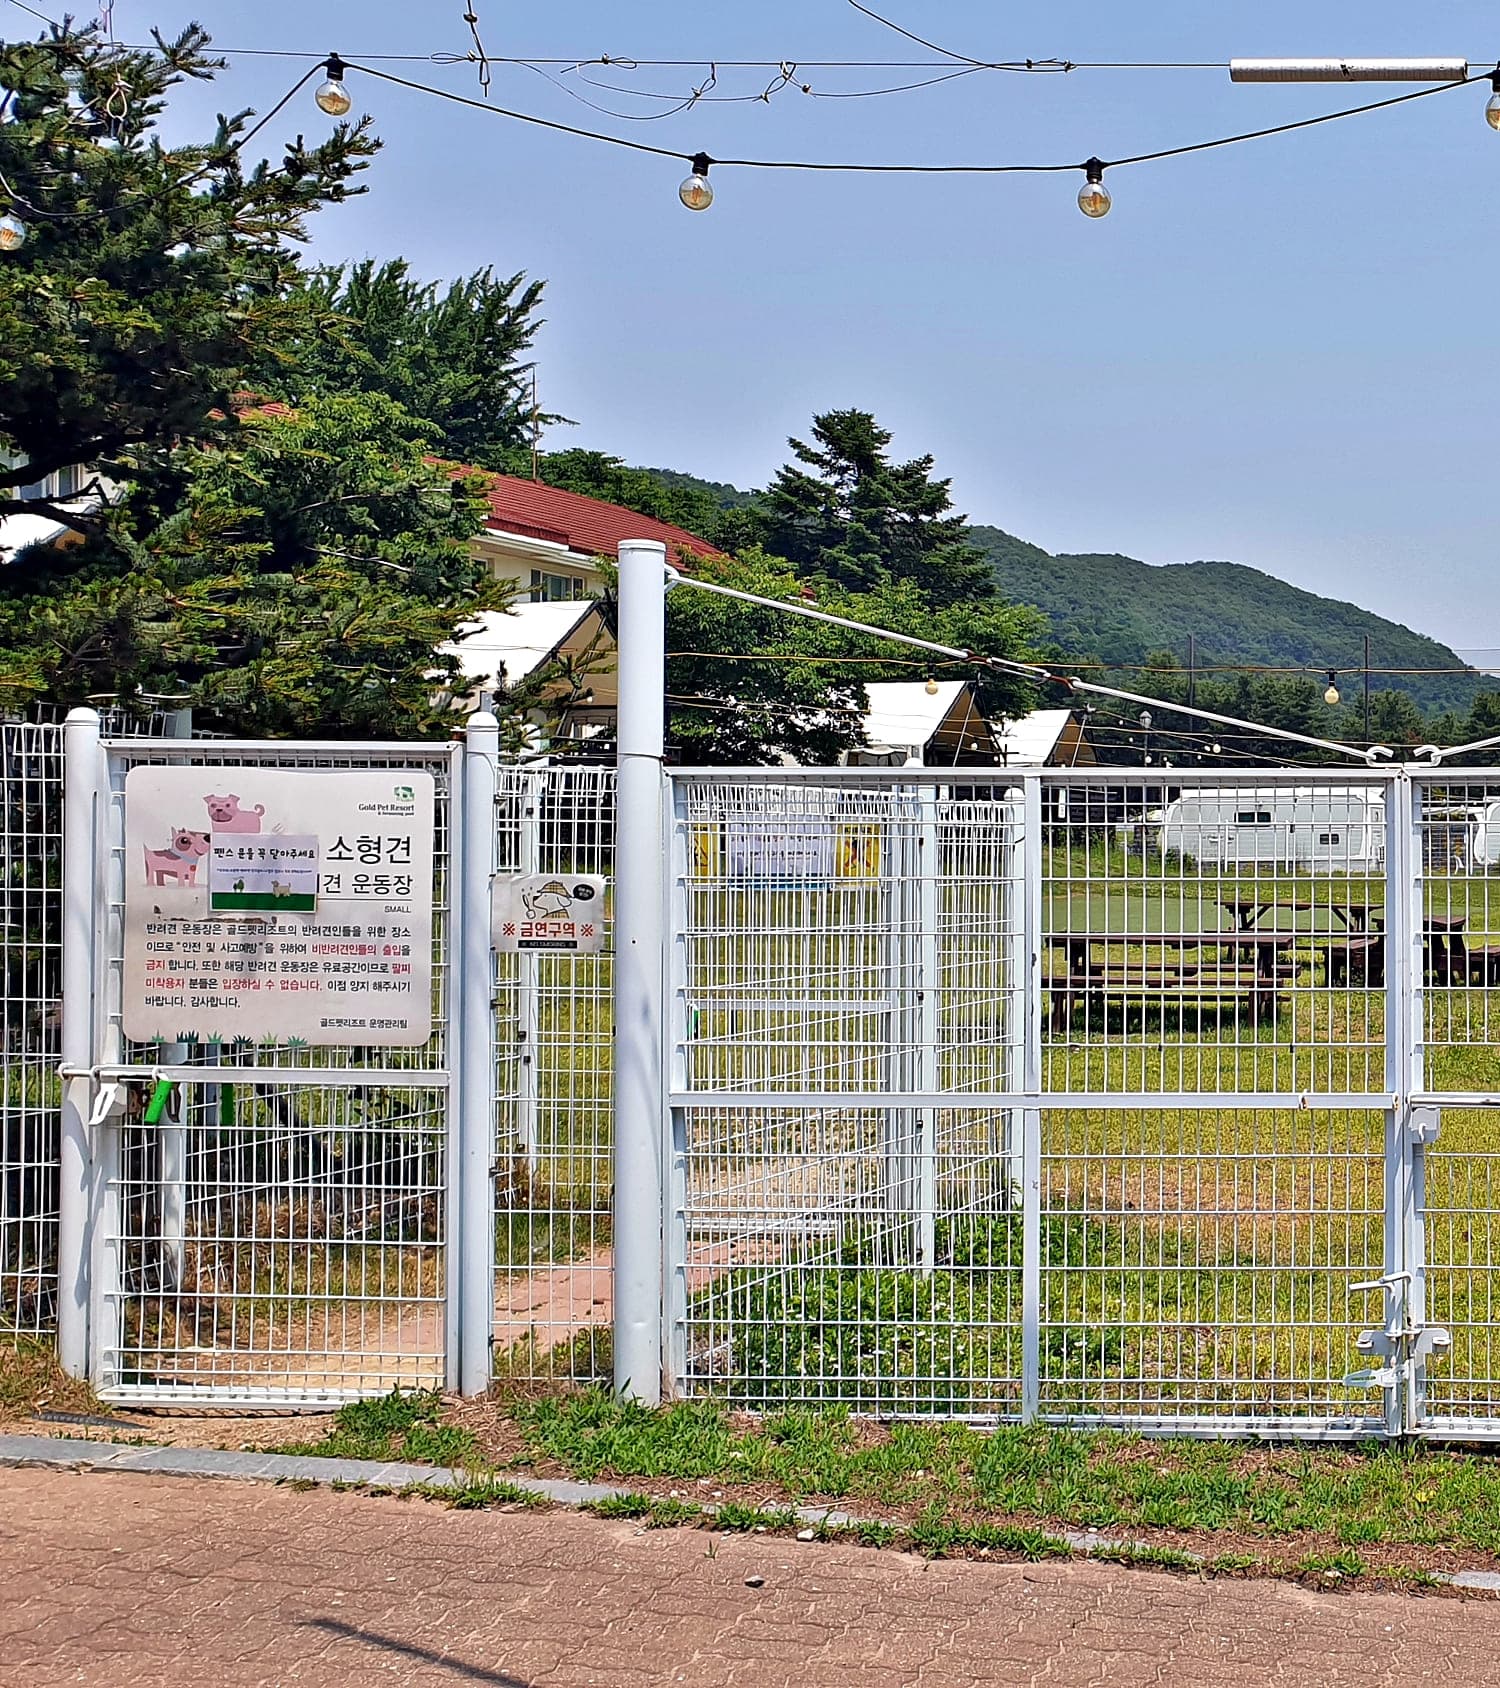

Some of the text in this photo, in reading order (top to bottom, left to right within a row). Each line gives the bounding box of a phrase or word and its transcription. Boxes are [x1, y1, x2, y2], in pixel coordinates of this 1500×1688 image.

[326, 835, 411, 865] 소형견
[351, 874, 413, 895] 운동장
[384, 906, 411, 914] SMALL
[146, 923, 411, 938] 반려견 운동장은 골드펫리조트의 반려견인들을 위한 장소
[521, 923, 575, 938] 금연구역
[206, 942, 216, 953] 및
[279, 943, 307, 955] 위하여
[311, 944, 377, 956] 비반려견인들의
[145, 960, 165, 971] 금지
[168, 960, 199, 971] 합니다.
[201, 960, 221, 972] 또한
[224, 961, 244, 972] 해당
[247, 961, 277, 972] 반려견
[279, 961, 320, 973] 운동장은
[322, 962, 389, 974] 유료공간이므로
[145, 978, 185, 989] 미착용자
[222, 979, 260, 990] 입장하실
[265, 980, 275, 990] 수
[279, 980, 323, 991] 없습니다.
[327, 980, 346, 991] 이점
[350, 980, 369, 992] 양지
[372, 981, 411, 992] 해주시기
[145, 996, 240, 1008] 바랍니다. 감사합니다.
